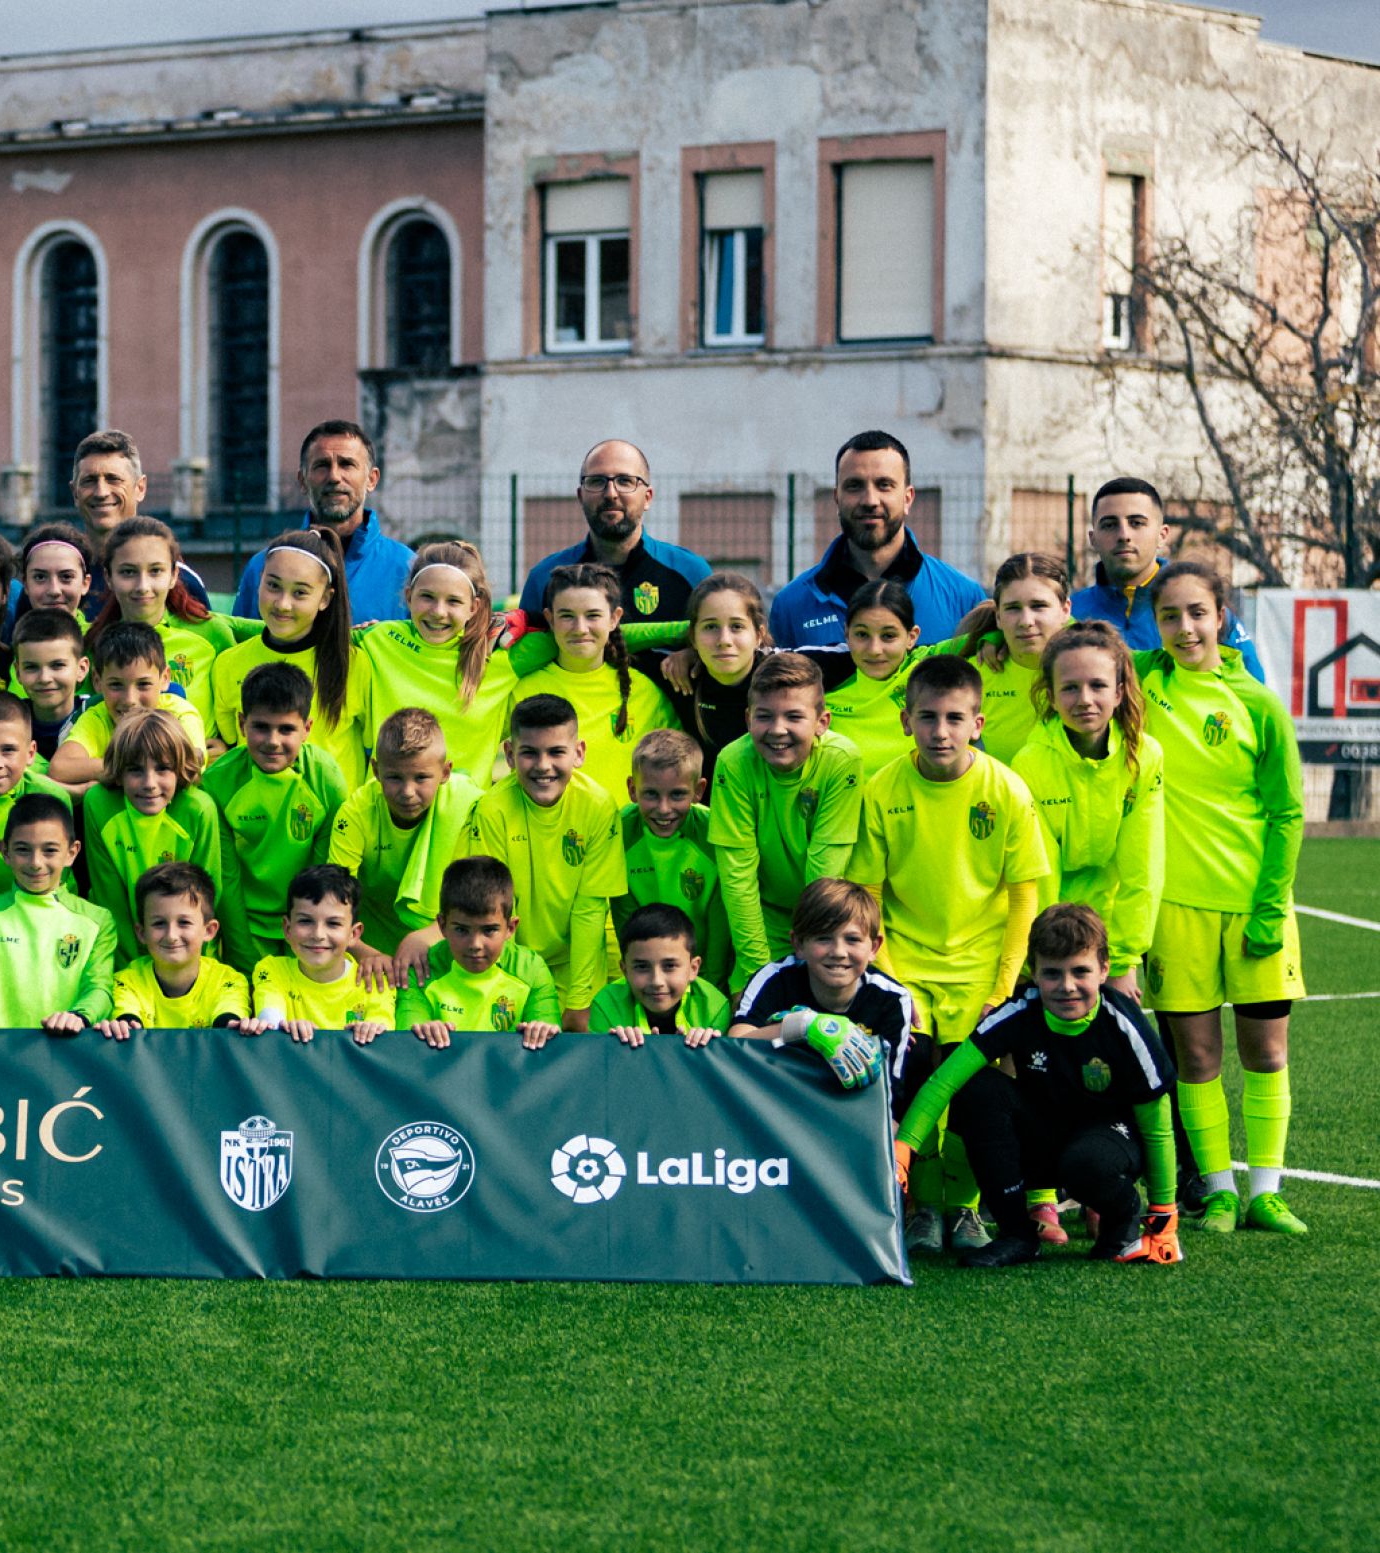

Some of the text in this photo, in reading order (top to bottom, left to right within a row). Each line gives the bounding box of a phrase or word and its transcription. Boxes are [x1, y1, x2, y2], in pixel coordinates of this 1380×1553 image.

[802, 614, 838, 629] KELME
[387, 629, 422, 654] KELME
[1041, 796, 1073, 805] KELME
[224, 1138, 241, 1147] NK
[268, 1137, 291, 1147] 1961
[391, 1125, 460, 1145] DEPORTIVO
[636, 1148, 790, 1194] LaLiga
[225, 1153, 290, 1209] ISTRA
[399, 1194, 451, 1209] ALAVÉS
